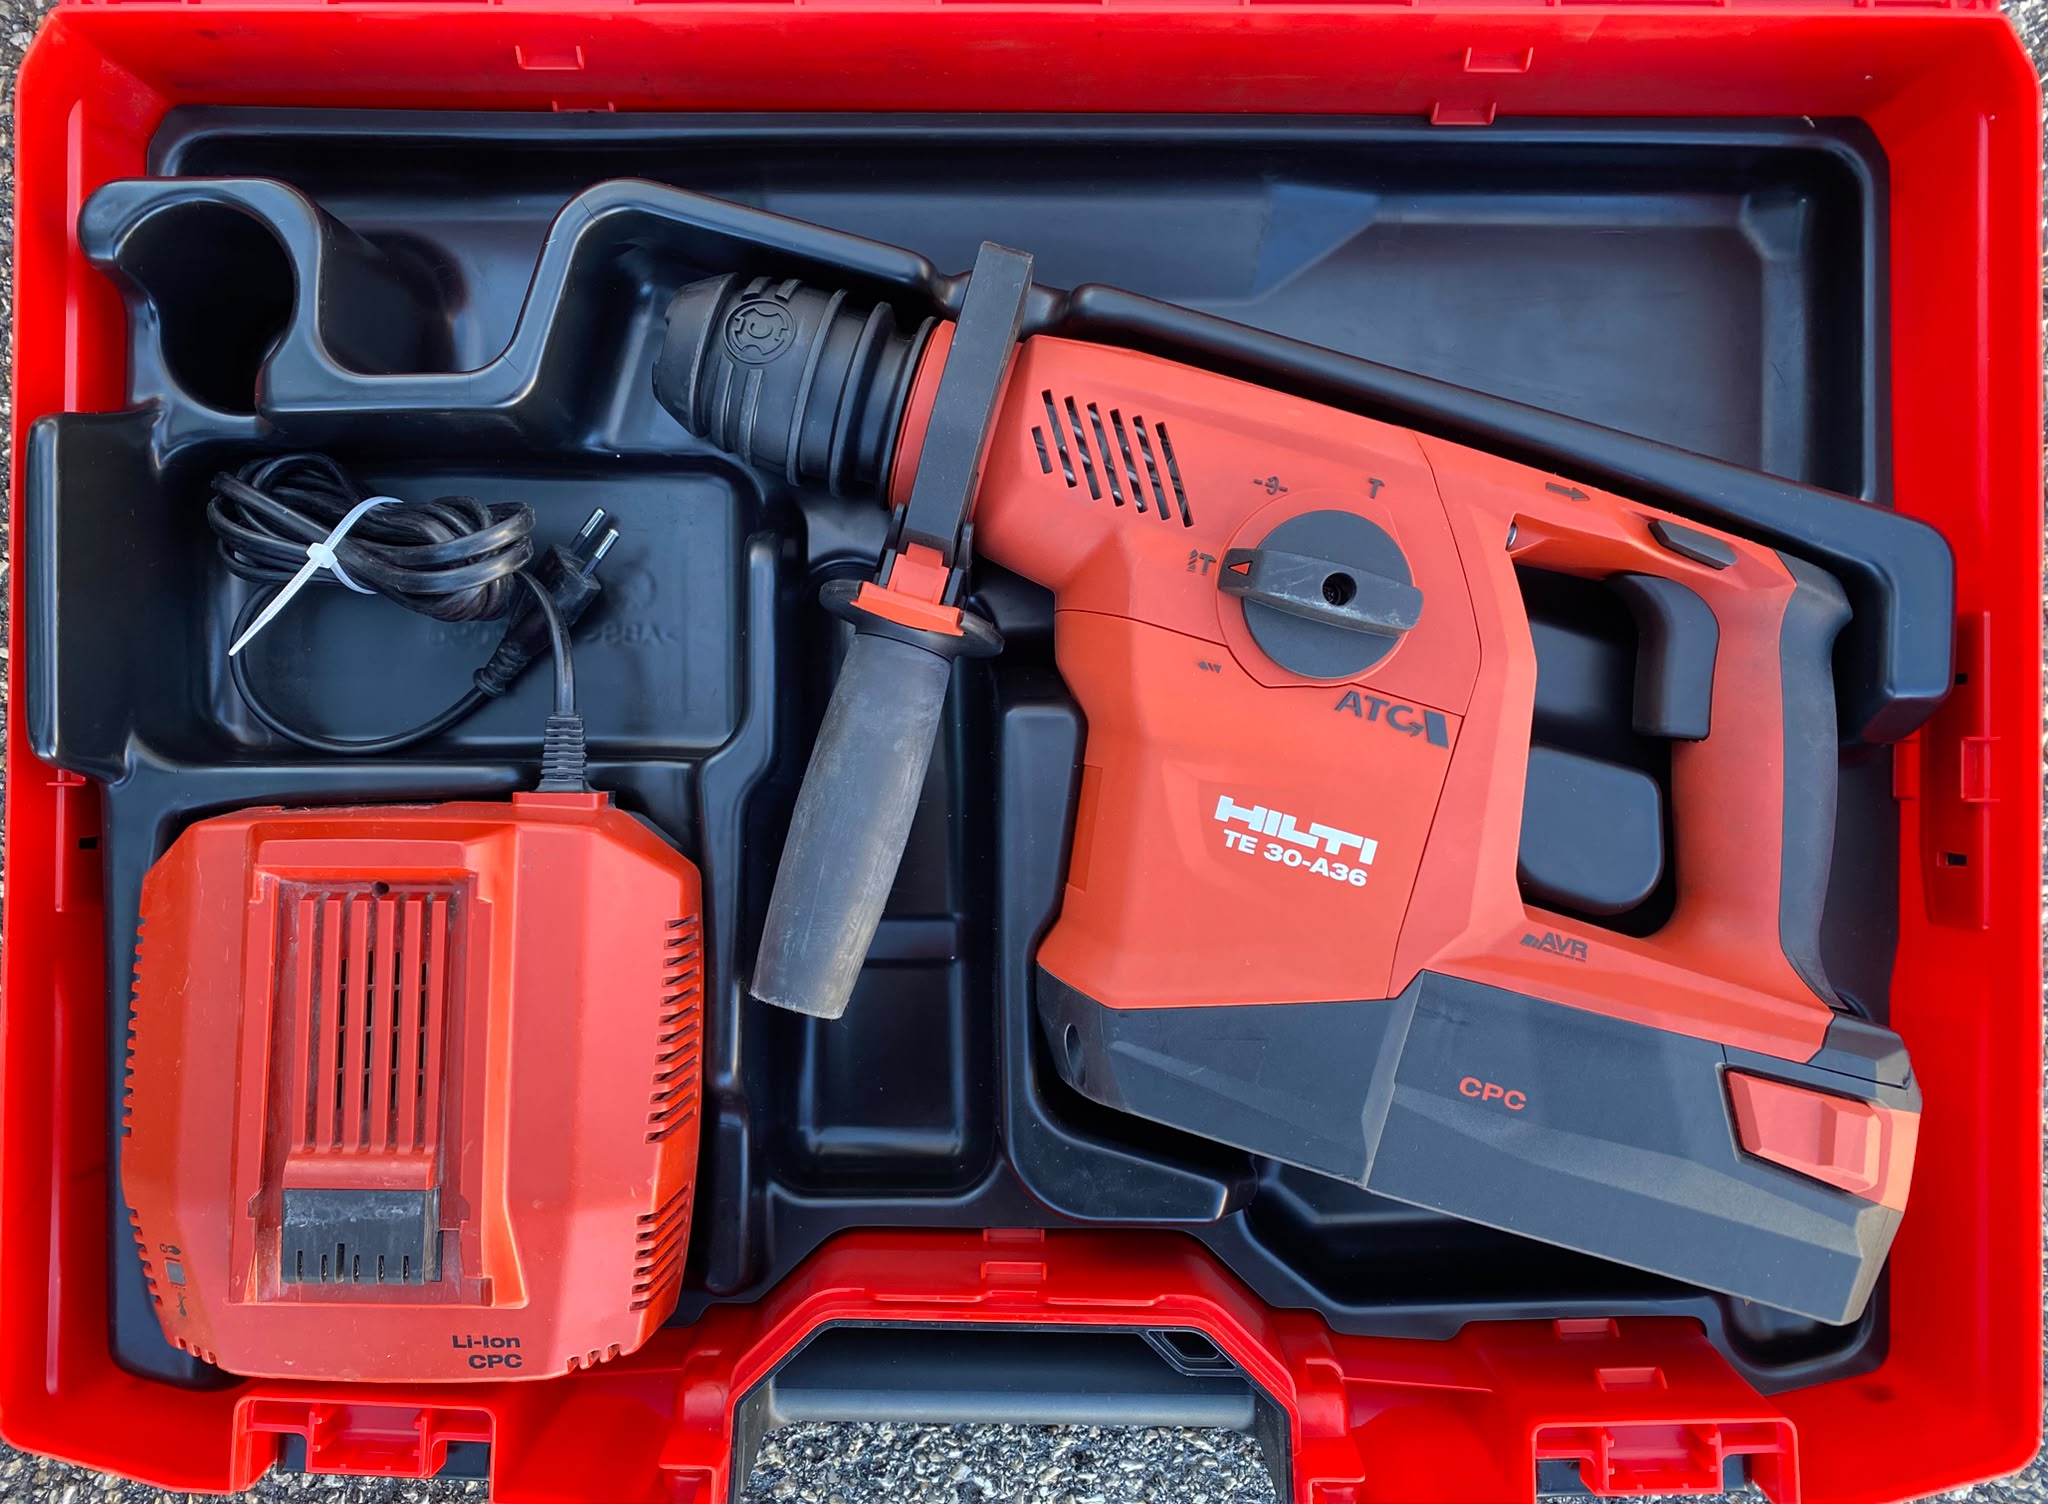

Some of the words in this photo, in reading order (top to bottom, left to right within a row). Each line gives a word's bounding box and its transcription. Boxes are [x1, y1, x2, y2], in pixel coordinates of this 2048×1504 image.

[1334, 690, 1424, 737] ATC
[1214, 795, 1378, 865] HILTI
[1223, 828, 1258, 855] TE
[1263, 843, 1368, 887] 30-A36
[1540, 931, 1588, 960] AVR
[1459, 1076, 1527, 1111] CPC
[452, 1335, 520, 1349] Li-Ion
[468, 1353, 523, 1369] CPC
